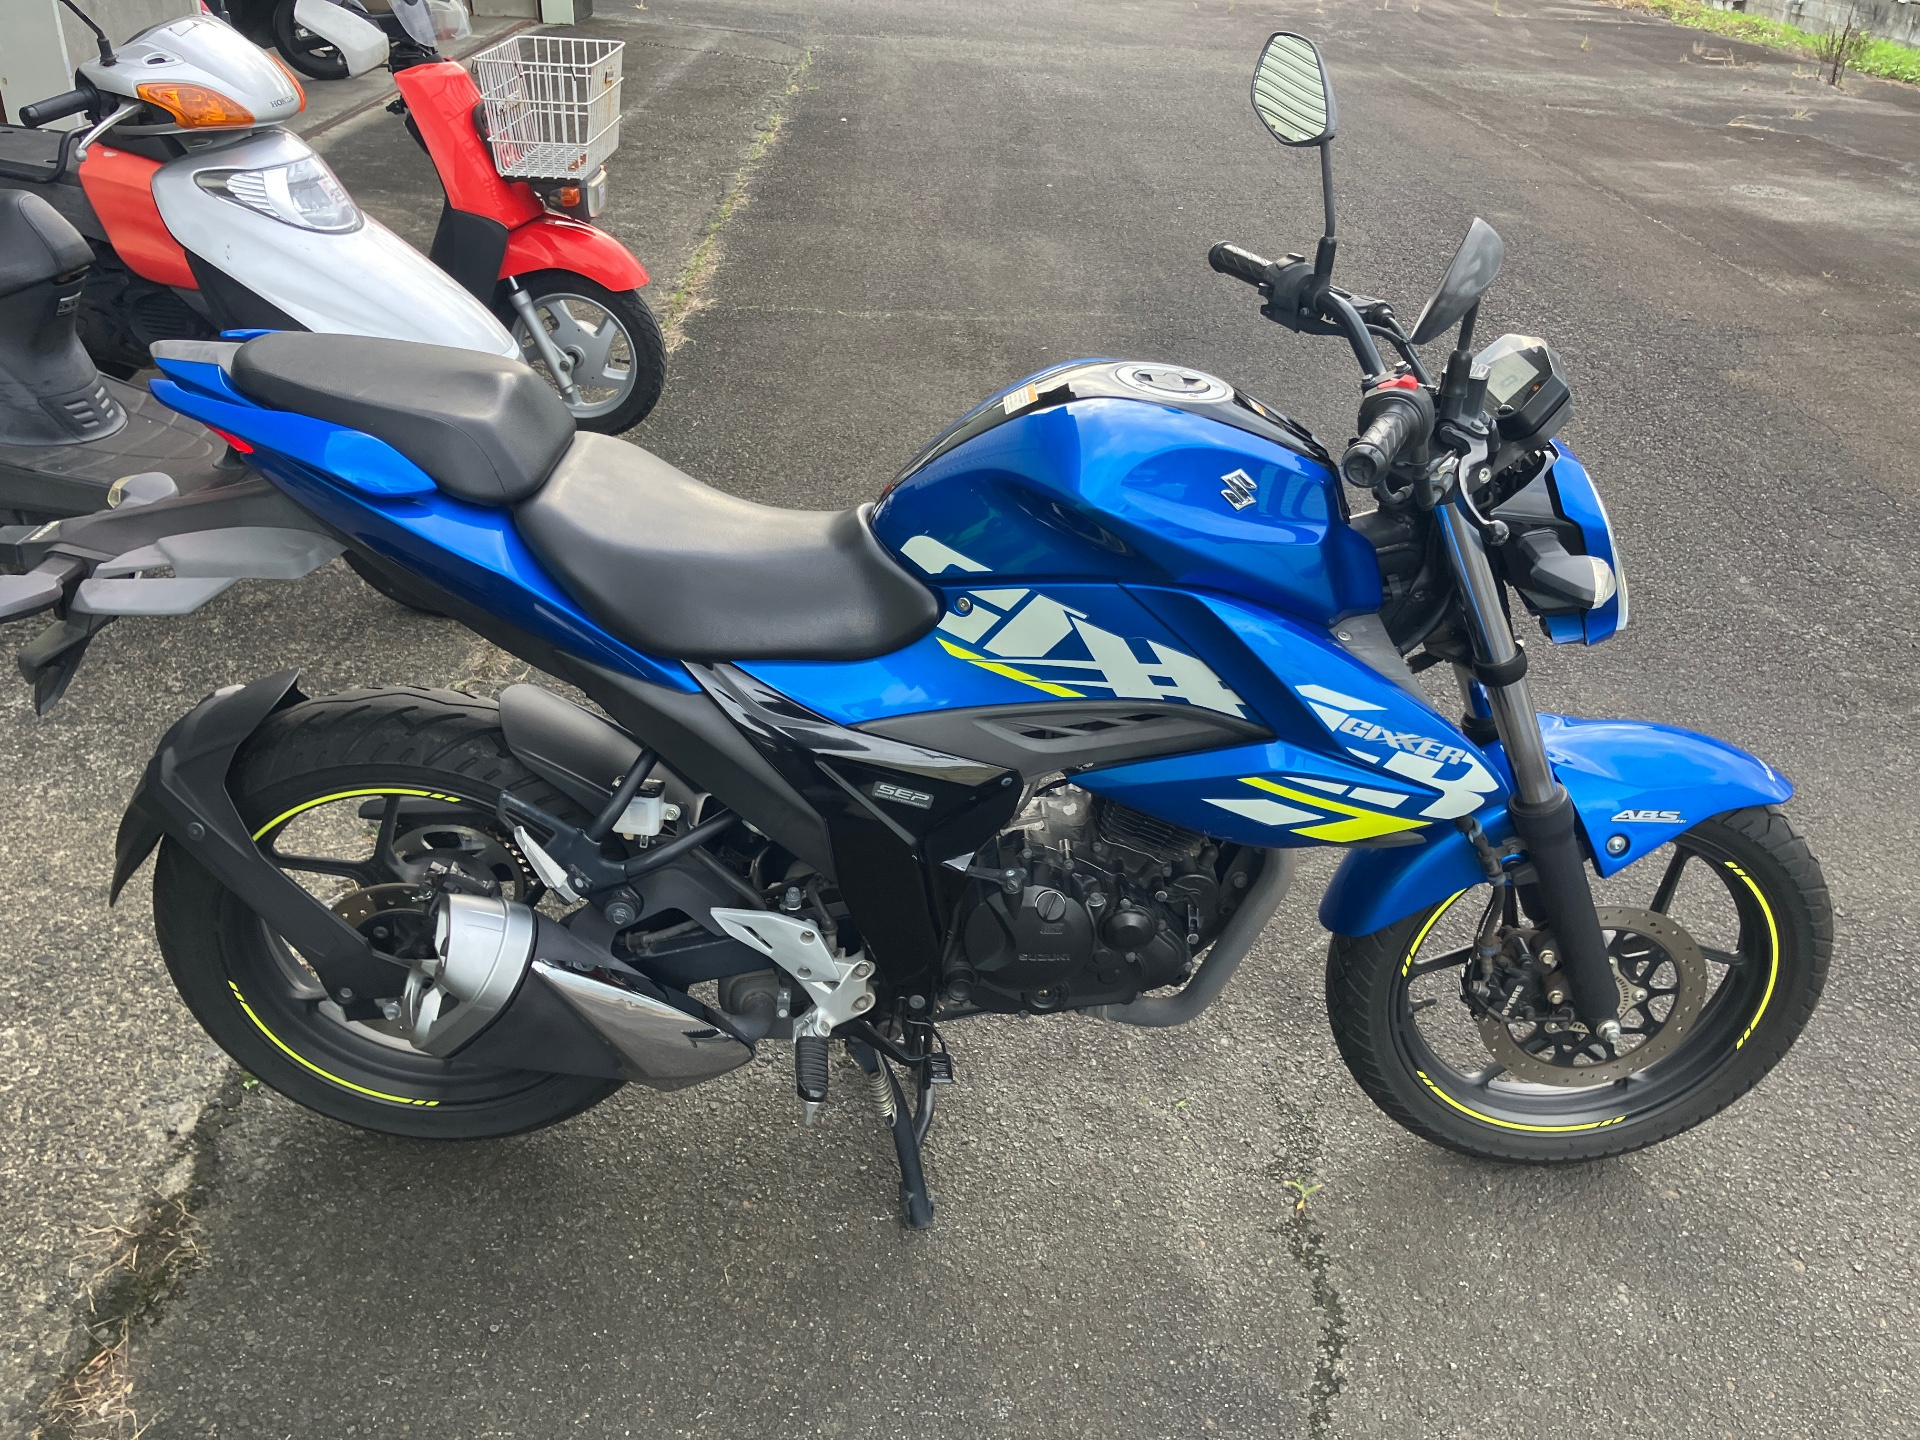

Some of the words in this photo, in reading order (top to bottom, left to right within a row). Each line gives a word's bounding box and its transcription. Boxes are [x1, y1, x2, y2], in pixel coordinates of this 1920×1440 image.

[269, 96, 295, 108] HONDA
[1338, 717, 1466, 765] GIXXER
[876, 784, 930, 801] SEP
[1610, 809, 1681, 820] ABS
[1018, 953, 1070, 962] SUZUKI
[1501, 985, 1524, 1016] BYBRE
